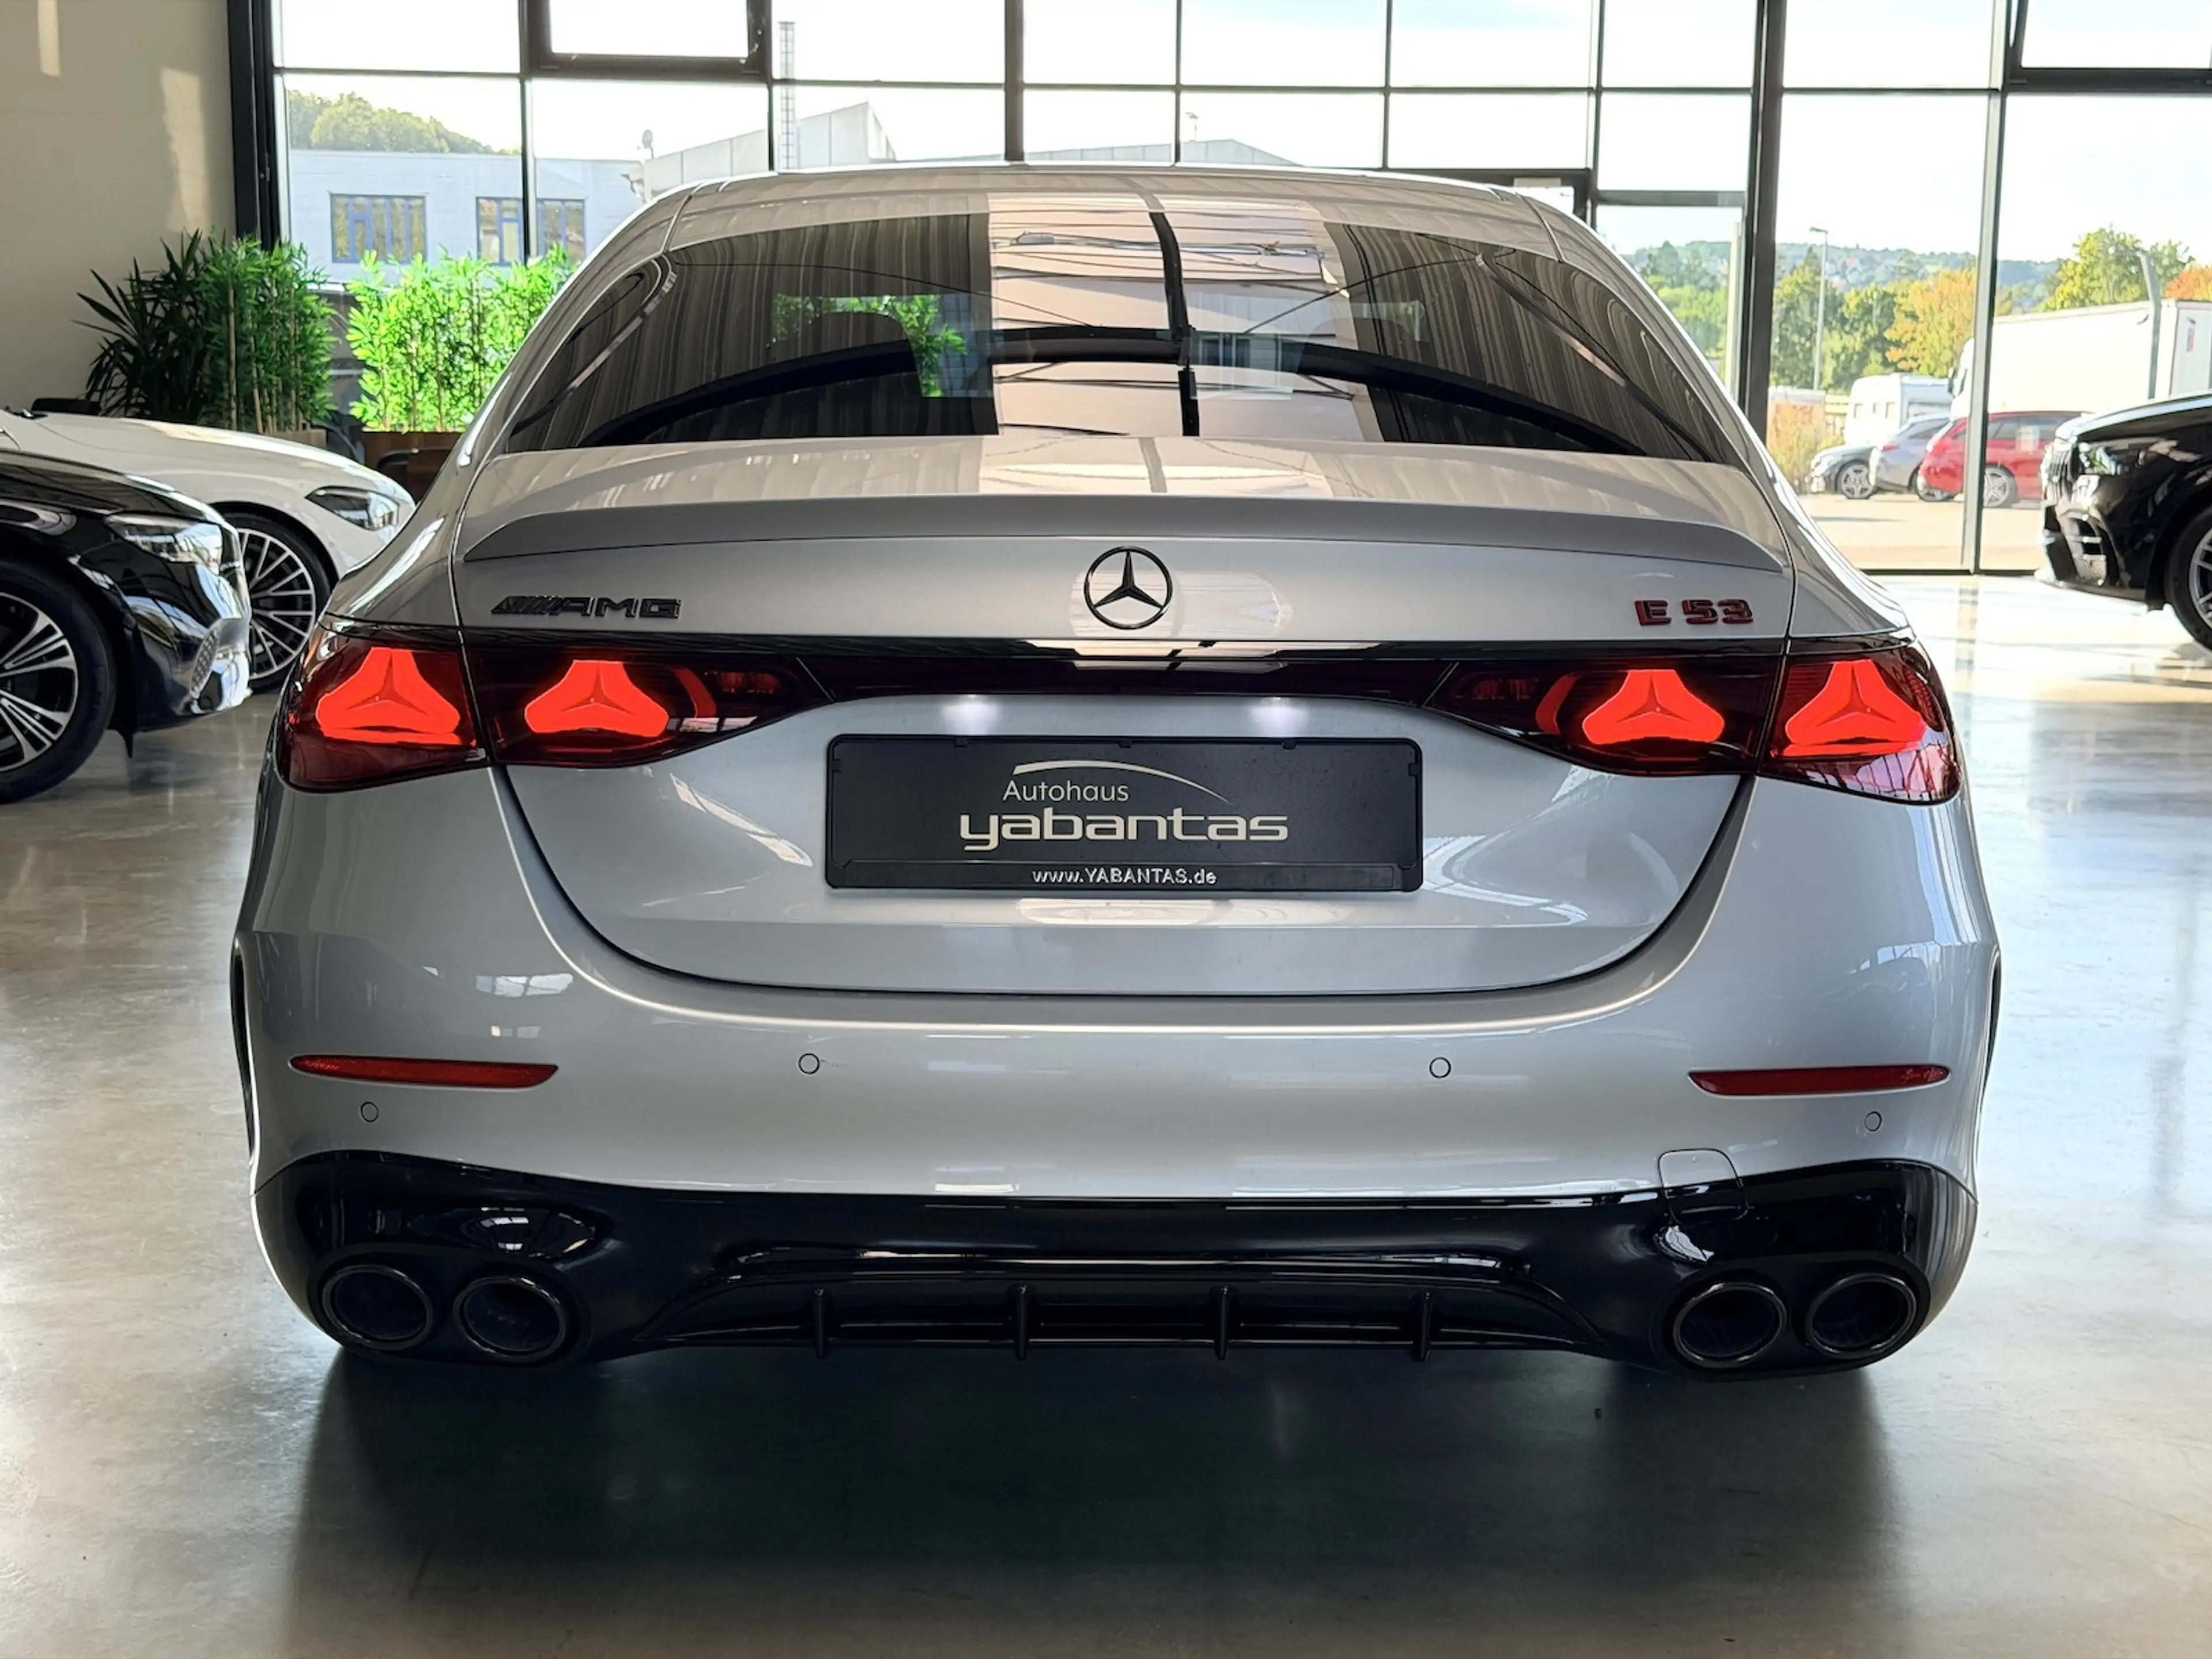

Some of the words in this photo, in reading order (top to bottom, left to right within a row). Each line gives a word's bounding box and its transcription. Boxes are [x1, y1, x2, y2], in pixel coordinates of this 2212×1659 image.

[547, 596, 682, 619] AMG
[1634, 600, 1672, 626] E
[1681, 599, 1754, 624] 53
[1002, 779, 1129, 801] Autohaus
[960, 807, 1288, 851] yabantas
[1032, 868, 1217, 884] www.YABANTAS.de
